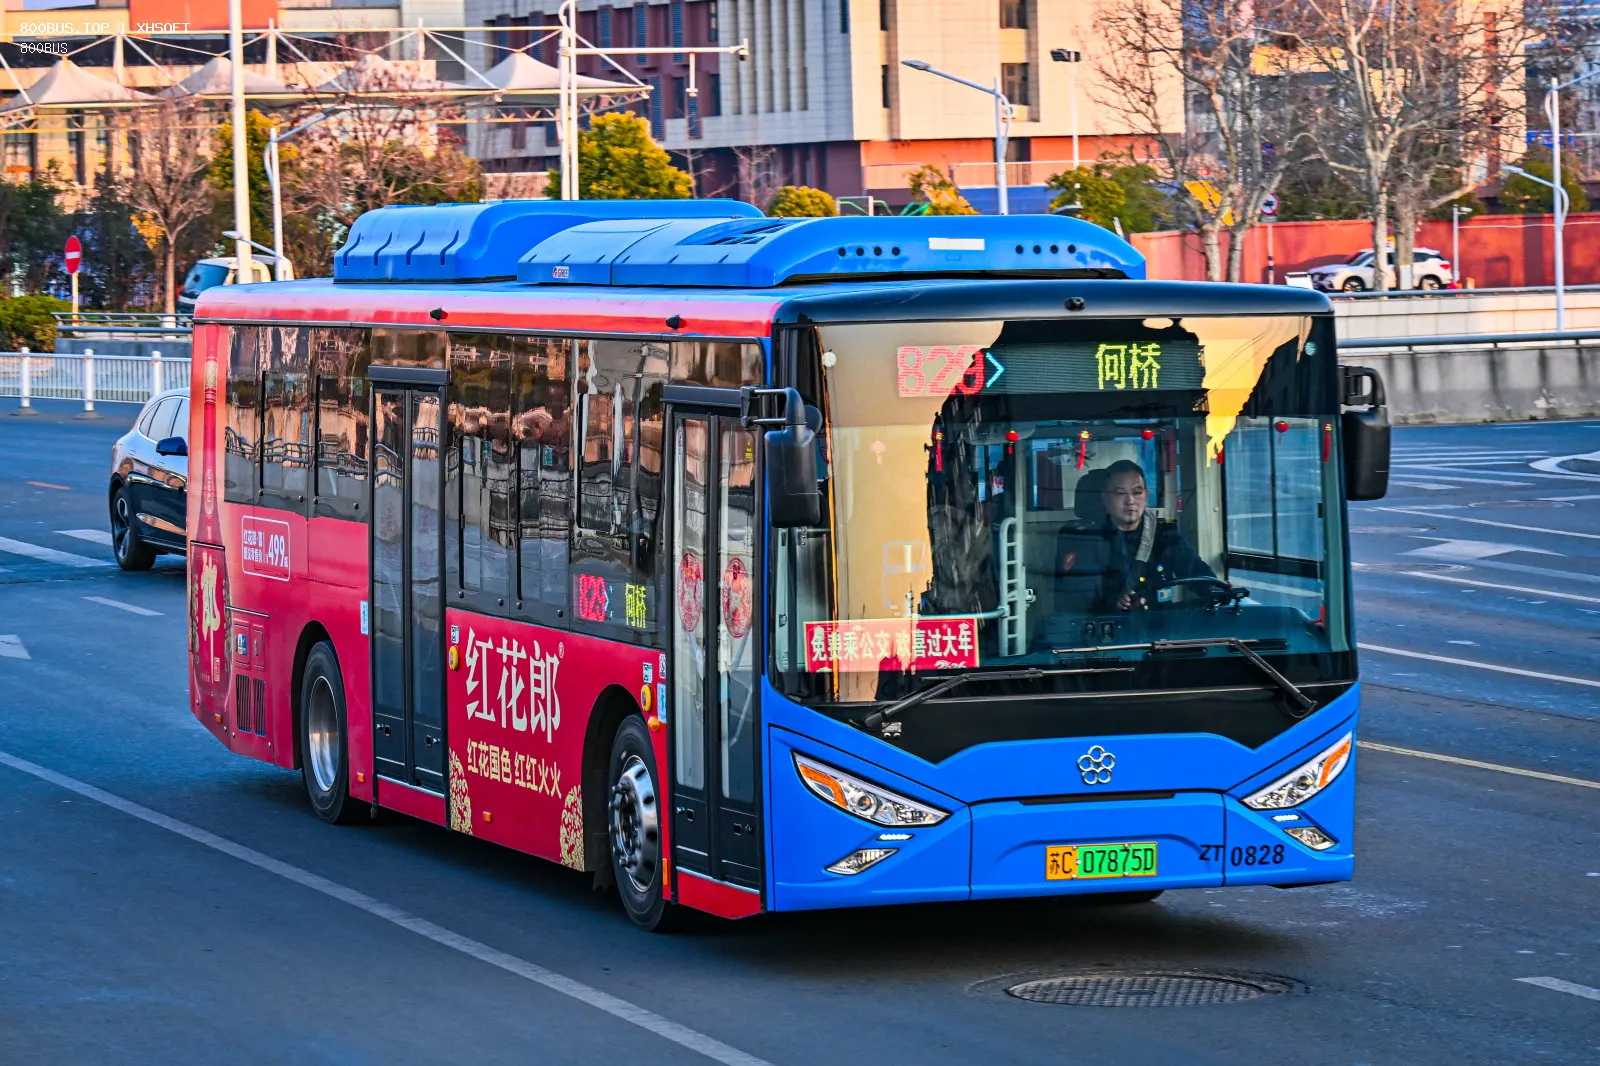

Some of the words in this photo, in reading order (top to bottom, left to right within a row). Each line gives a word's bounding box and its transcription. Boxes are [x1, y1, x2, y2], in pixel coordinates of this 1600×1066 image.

[897, 344, 985, 396] 829
[1095, 343, 1161, 390] 何桥
[580, 573, 606, 622] 829
[625, 583, 646, 629] 何桥
[811, 625, 891, 662] 免费乘公交
[465, 626, 562, 743] 红花郎
[467, 738, 512, 784] 红花国色
[514, 751, 562, 799] 红红火火
[1050, 851, 1073, 875] 苏C
[1083, 847, 1155, 874] 07875D
[1199, 844, 1224, 861] ZT
[1230, 844, 1285, 866] 0828
